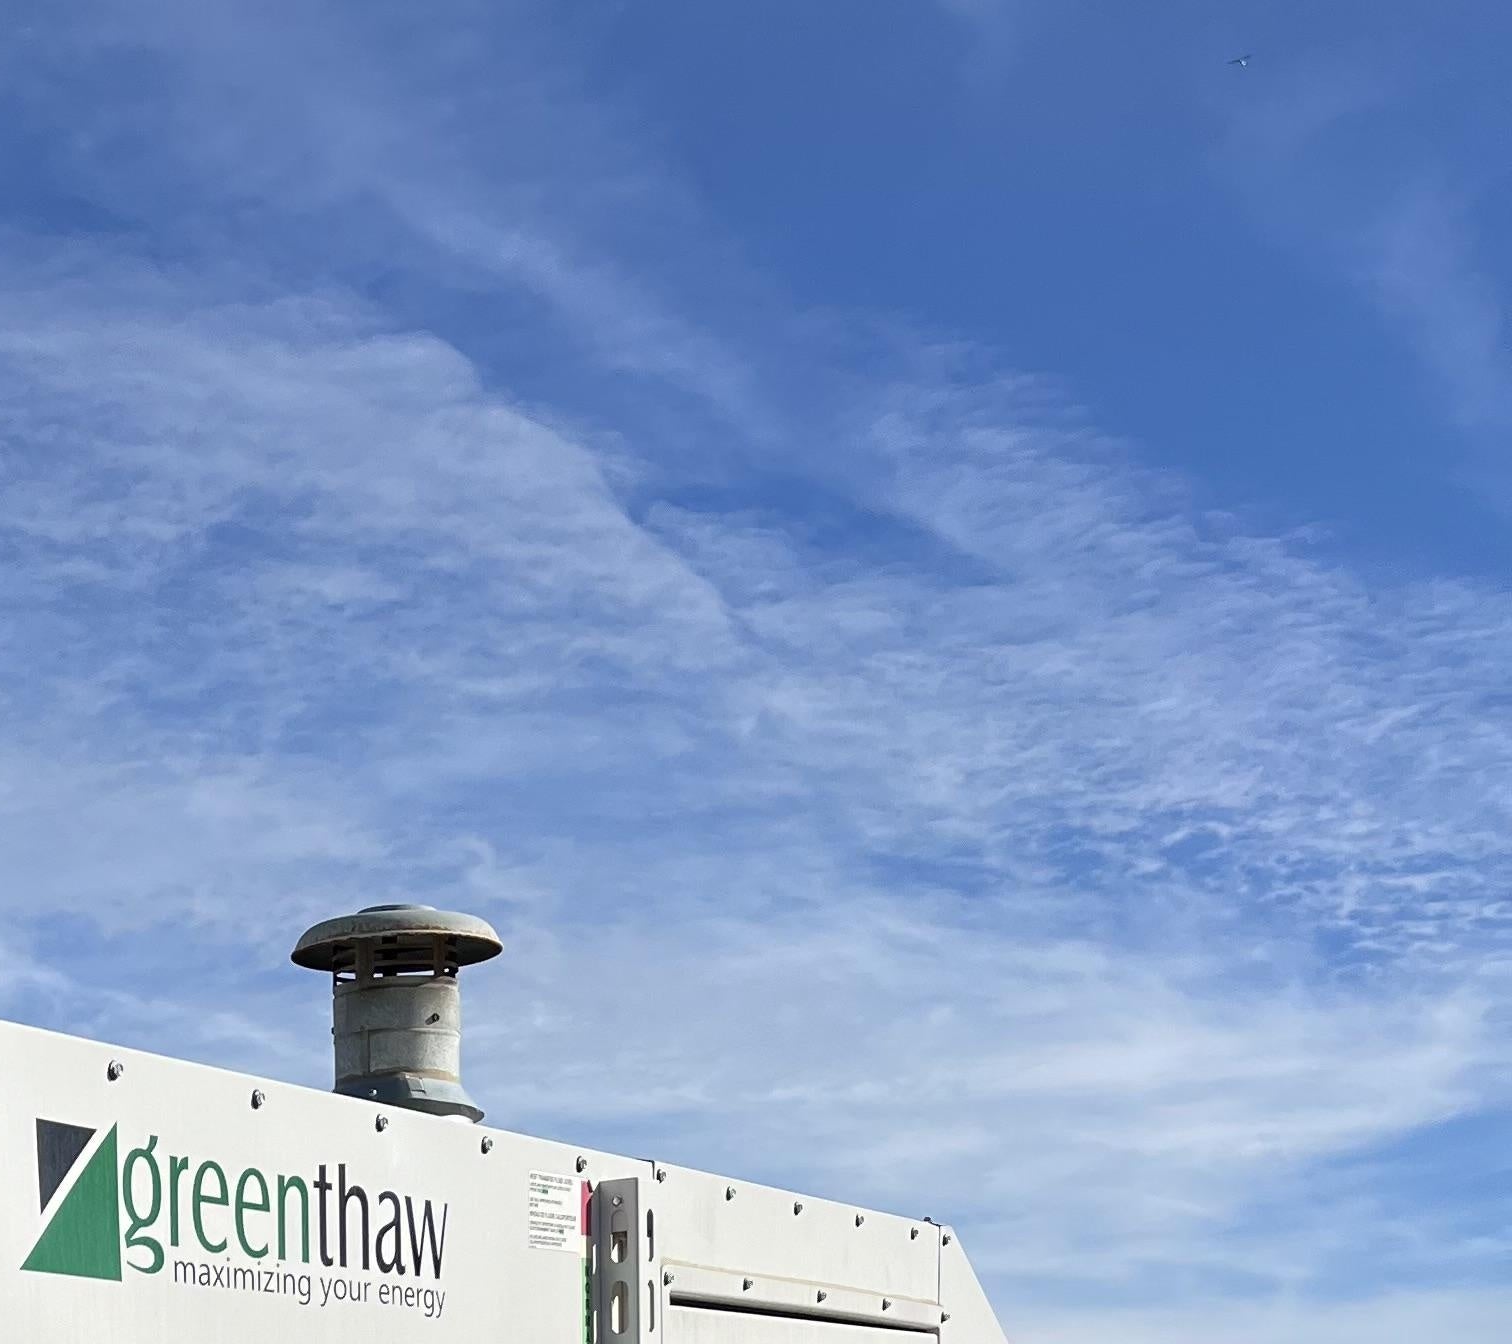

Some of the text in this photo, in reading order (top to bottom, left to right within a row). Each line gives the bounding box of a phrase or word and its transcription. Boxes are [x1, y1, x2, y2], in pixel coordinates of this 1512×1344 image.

[122, 1135, 448, 1280] greenthaw
[174, 1257, 445, 1319] maximizing your energy
